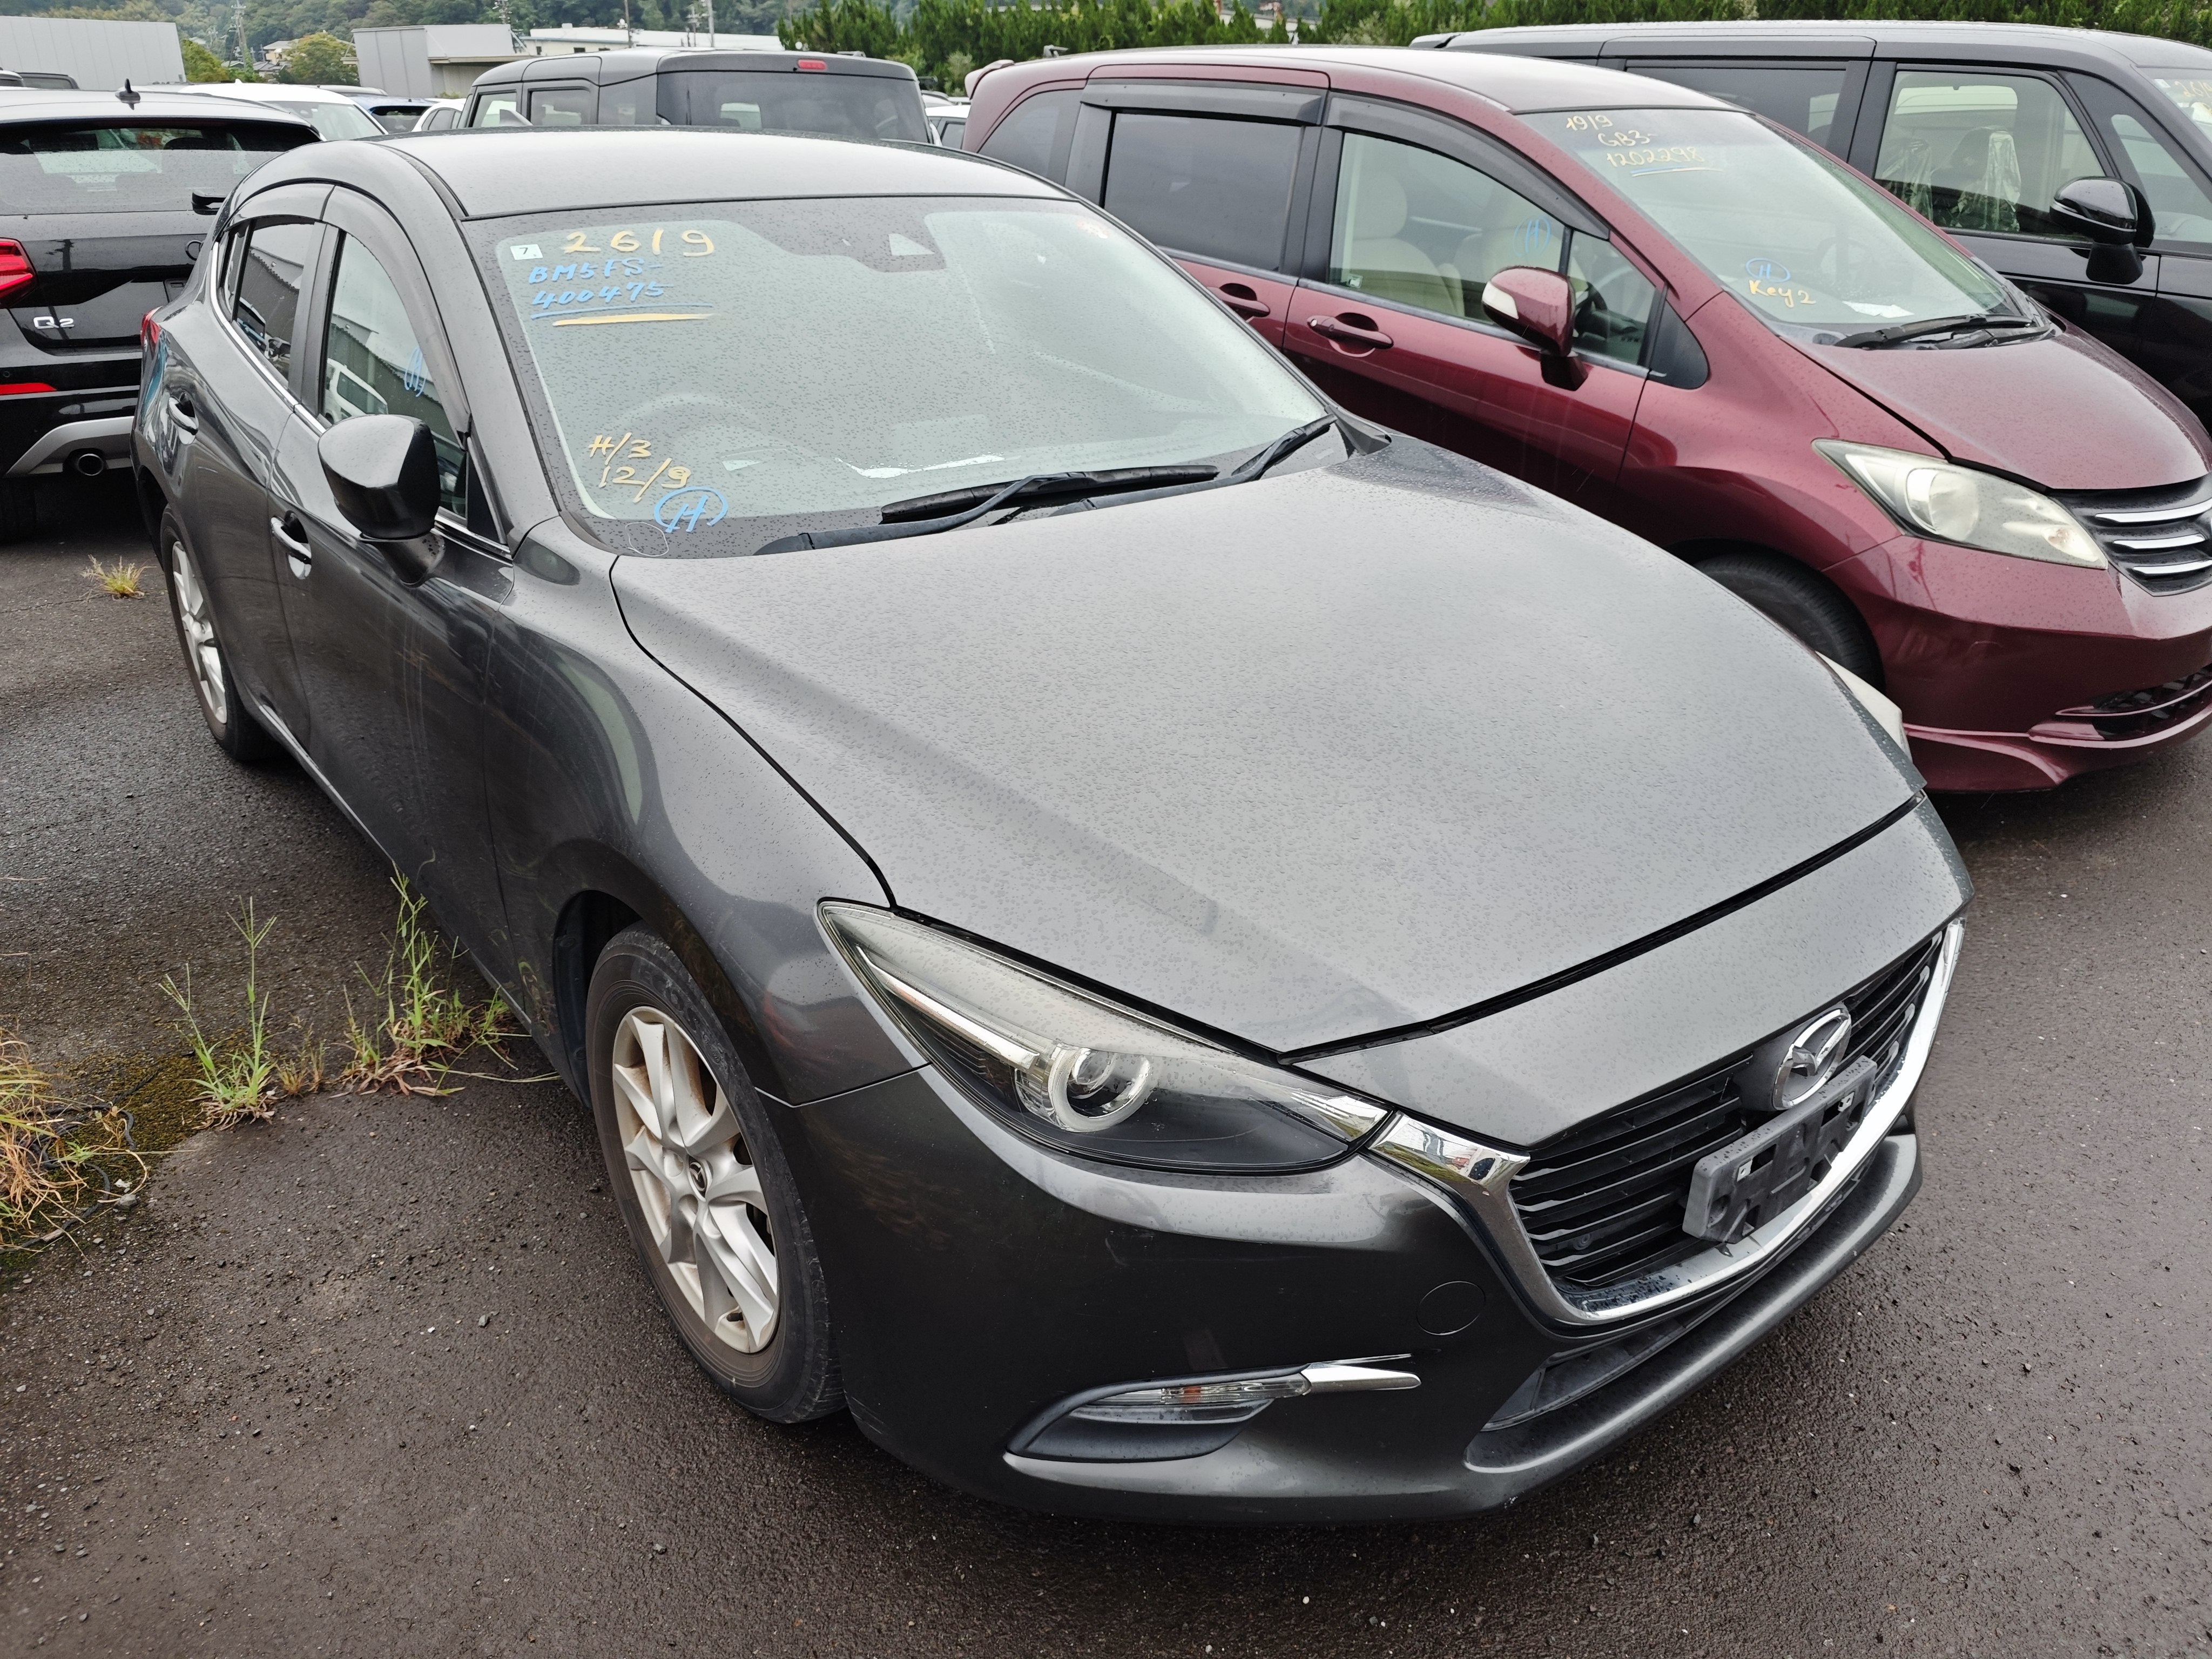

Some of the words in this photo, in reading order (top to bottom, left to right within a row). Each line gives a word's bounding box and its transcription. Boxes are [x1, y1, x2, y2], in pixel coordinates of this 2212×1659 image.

[1607, 146, 1704, 167] 1202298
[531, 281, 673, 309] 400475
[33, 316, 75, 329] Q2
[598, 458, 692, 503] 12/9
